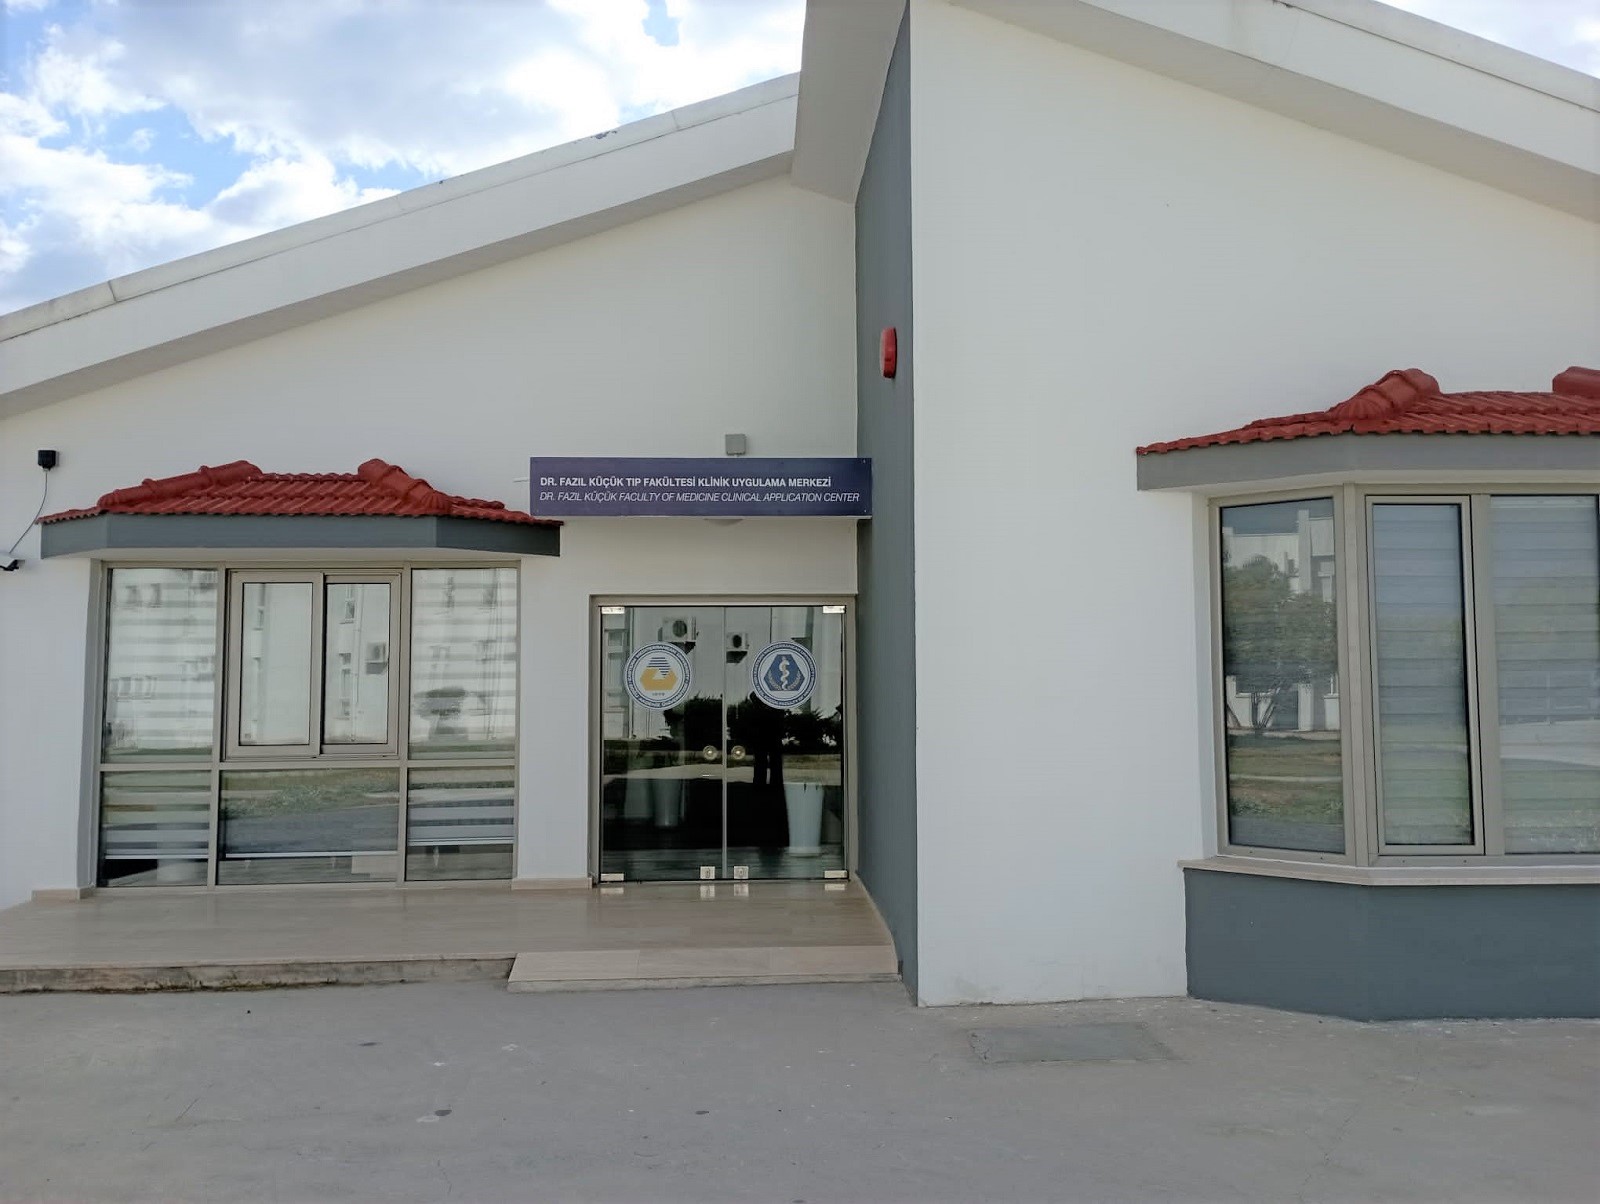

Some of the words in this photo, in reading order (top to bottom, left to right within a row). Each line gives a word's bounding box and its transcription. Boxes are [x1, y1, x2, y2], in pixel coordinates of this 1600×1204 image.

[540, 477, 557, 487] DR.
[559, 477, 586, 487] FAZIL
[589, 475, 624, 488] KÜÇÜK
[626, 477, 642, 487] TIP
[643, 475, 695, 487] FAKÜLTESİ
[697, 475, 730, 487] KLİNİK
[731, 477, 786, 487] UYGULAMA
[788, 476, 831, 487] MERKEZİ
[539, 492, 555, 501] DR.
[557, 492, 582, 501] FAZIL
[584, 491, 617, 503] KÜÇÜK
[618, 492, 660, 502] FACULTY
[661, 492, 675, 502] OF
[676, 492, 720, 502] MEDICINE
[721, 492, 761, 502] CLINICAL
[762, 492, 822, 502] APPLICATION
[823, 492, 860, 502] CENTER
